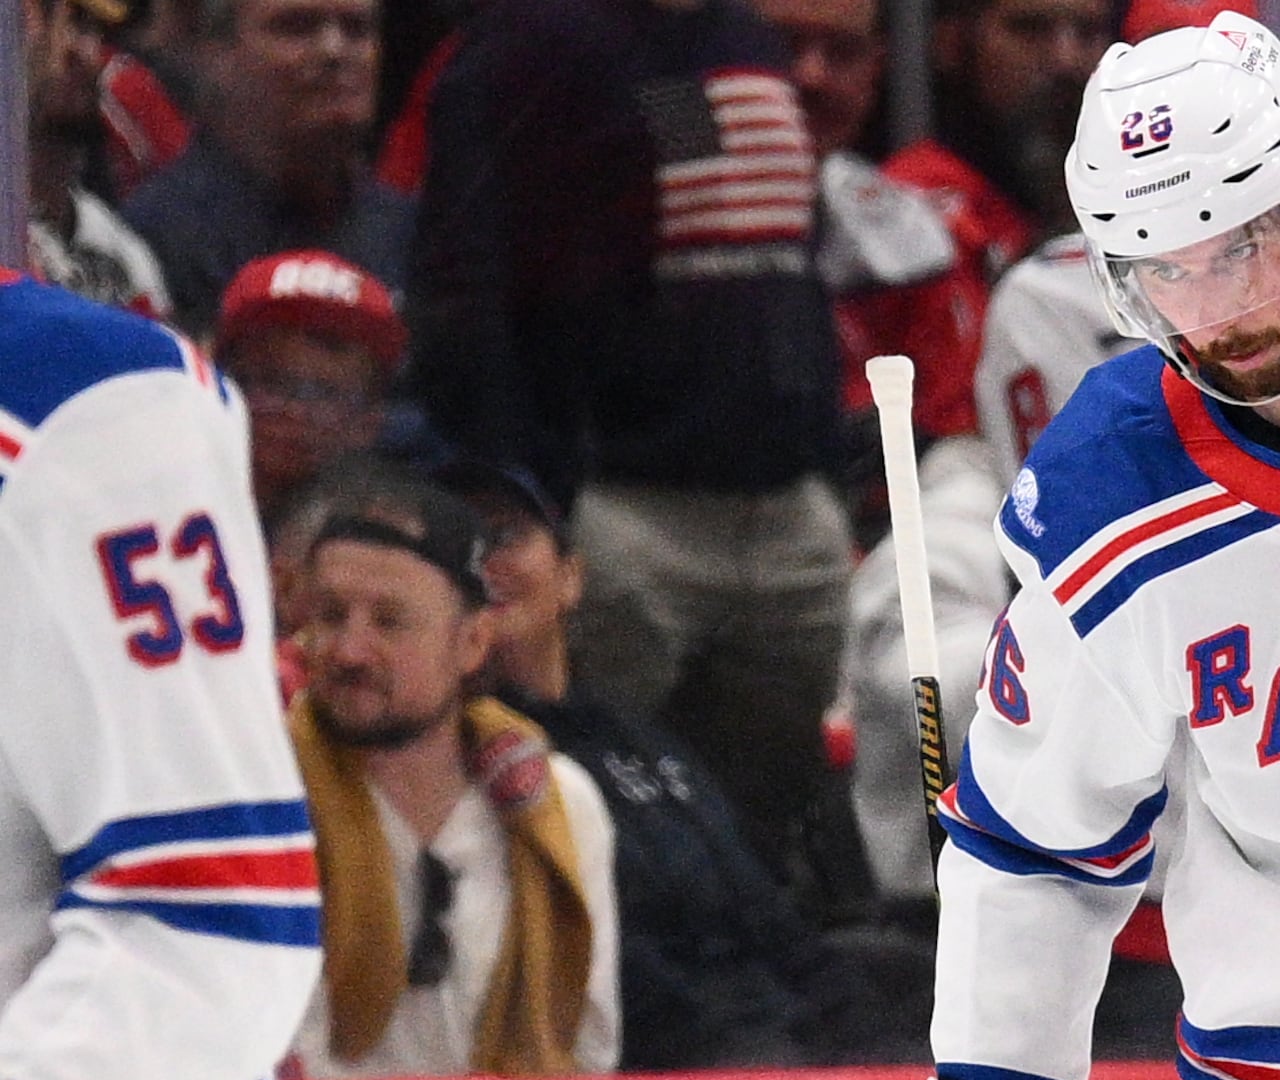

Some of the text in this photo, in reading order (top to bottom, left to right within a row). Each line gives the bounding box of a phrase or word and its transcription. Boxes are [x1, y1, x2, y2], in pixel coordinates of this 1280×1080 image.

[1120, 104, 1173, 151] 26
[1124, 170, 1191, 199] WARRIOR
[96, 511, 244, 670] 53
[978, 603, 1031, 727] 6
